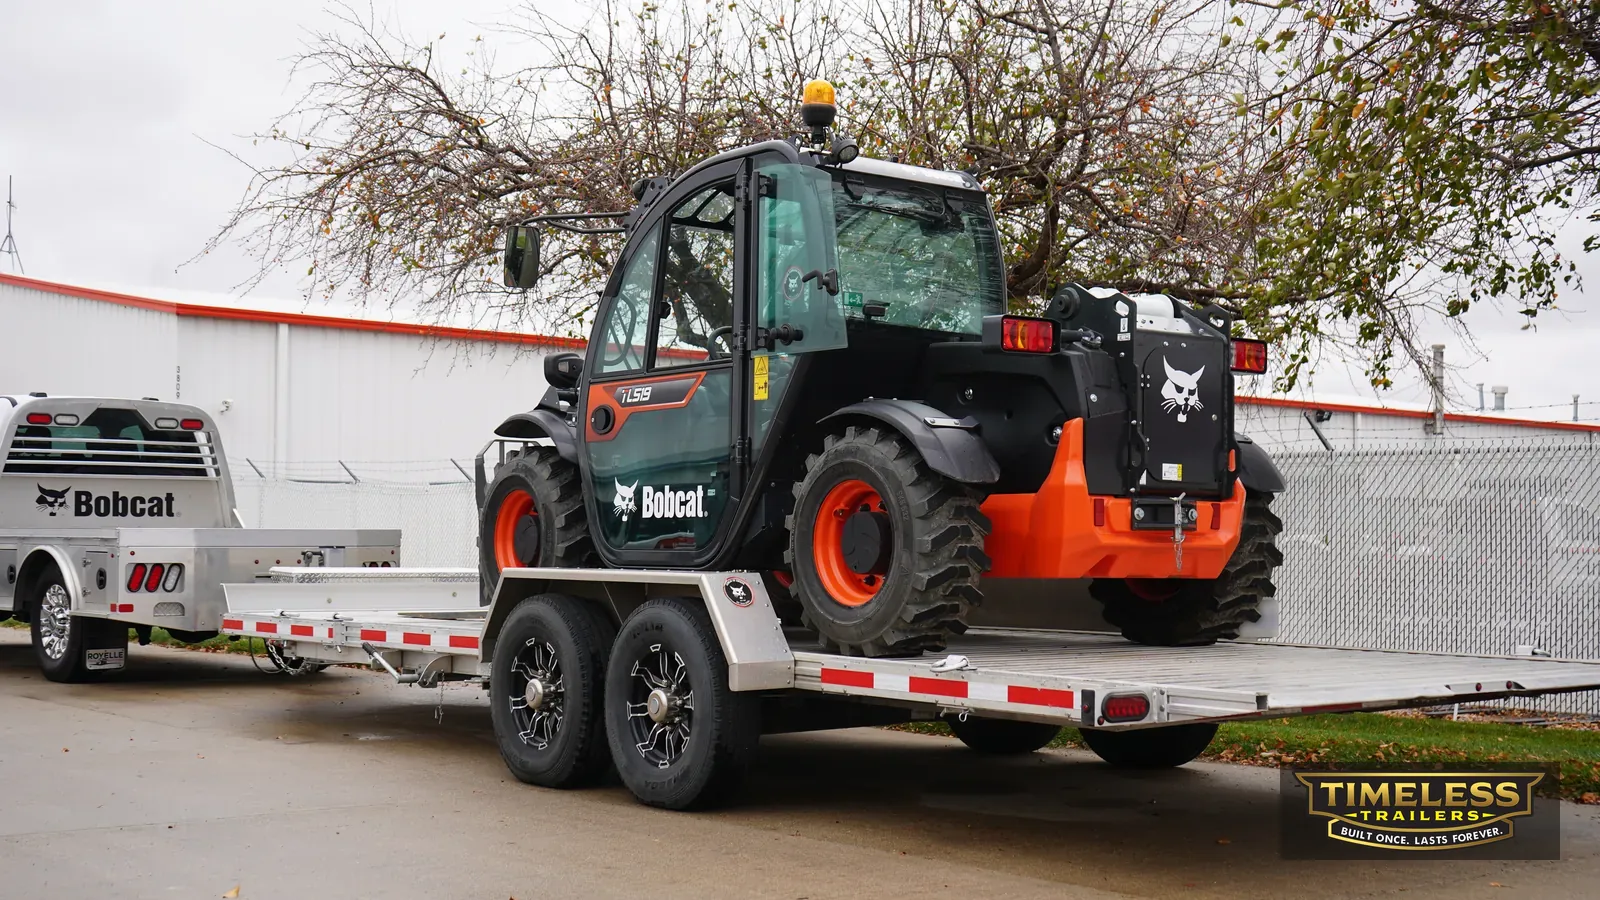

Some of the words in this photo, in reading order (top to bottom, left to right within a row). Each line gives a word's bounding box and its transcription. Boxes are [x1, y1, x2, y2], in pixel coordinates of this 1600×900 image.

[74, 490, 175, 518] Bobcat
[642, 485, 704, 519] Bobcat
[87, 651, 124, 660] ROYELLE
